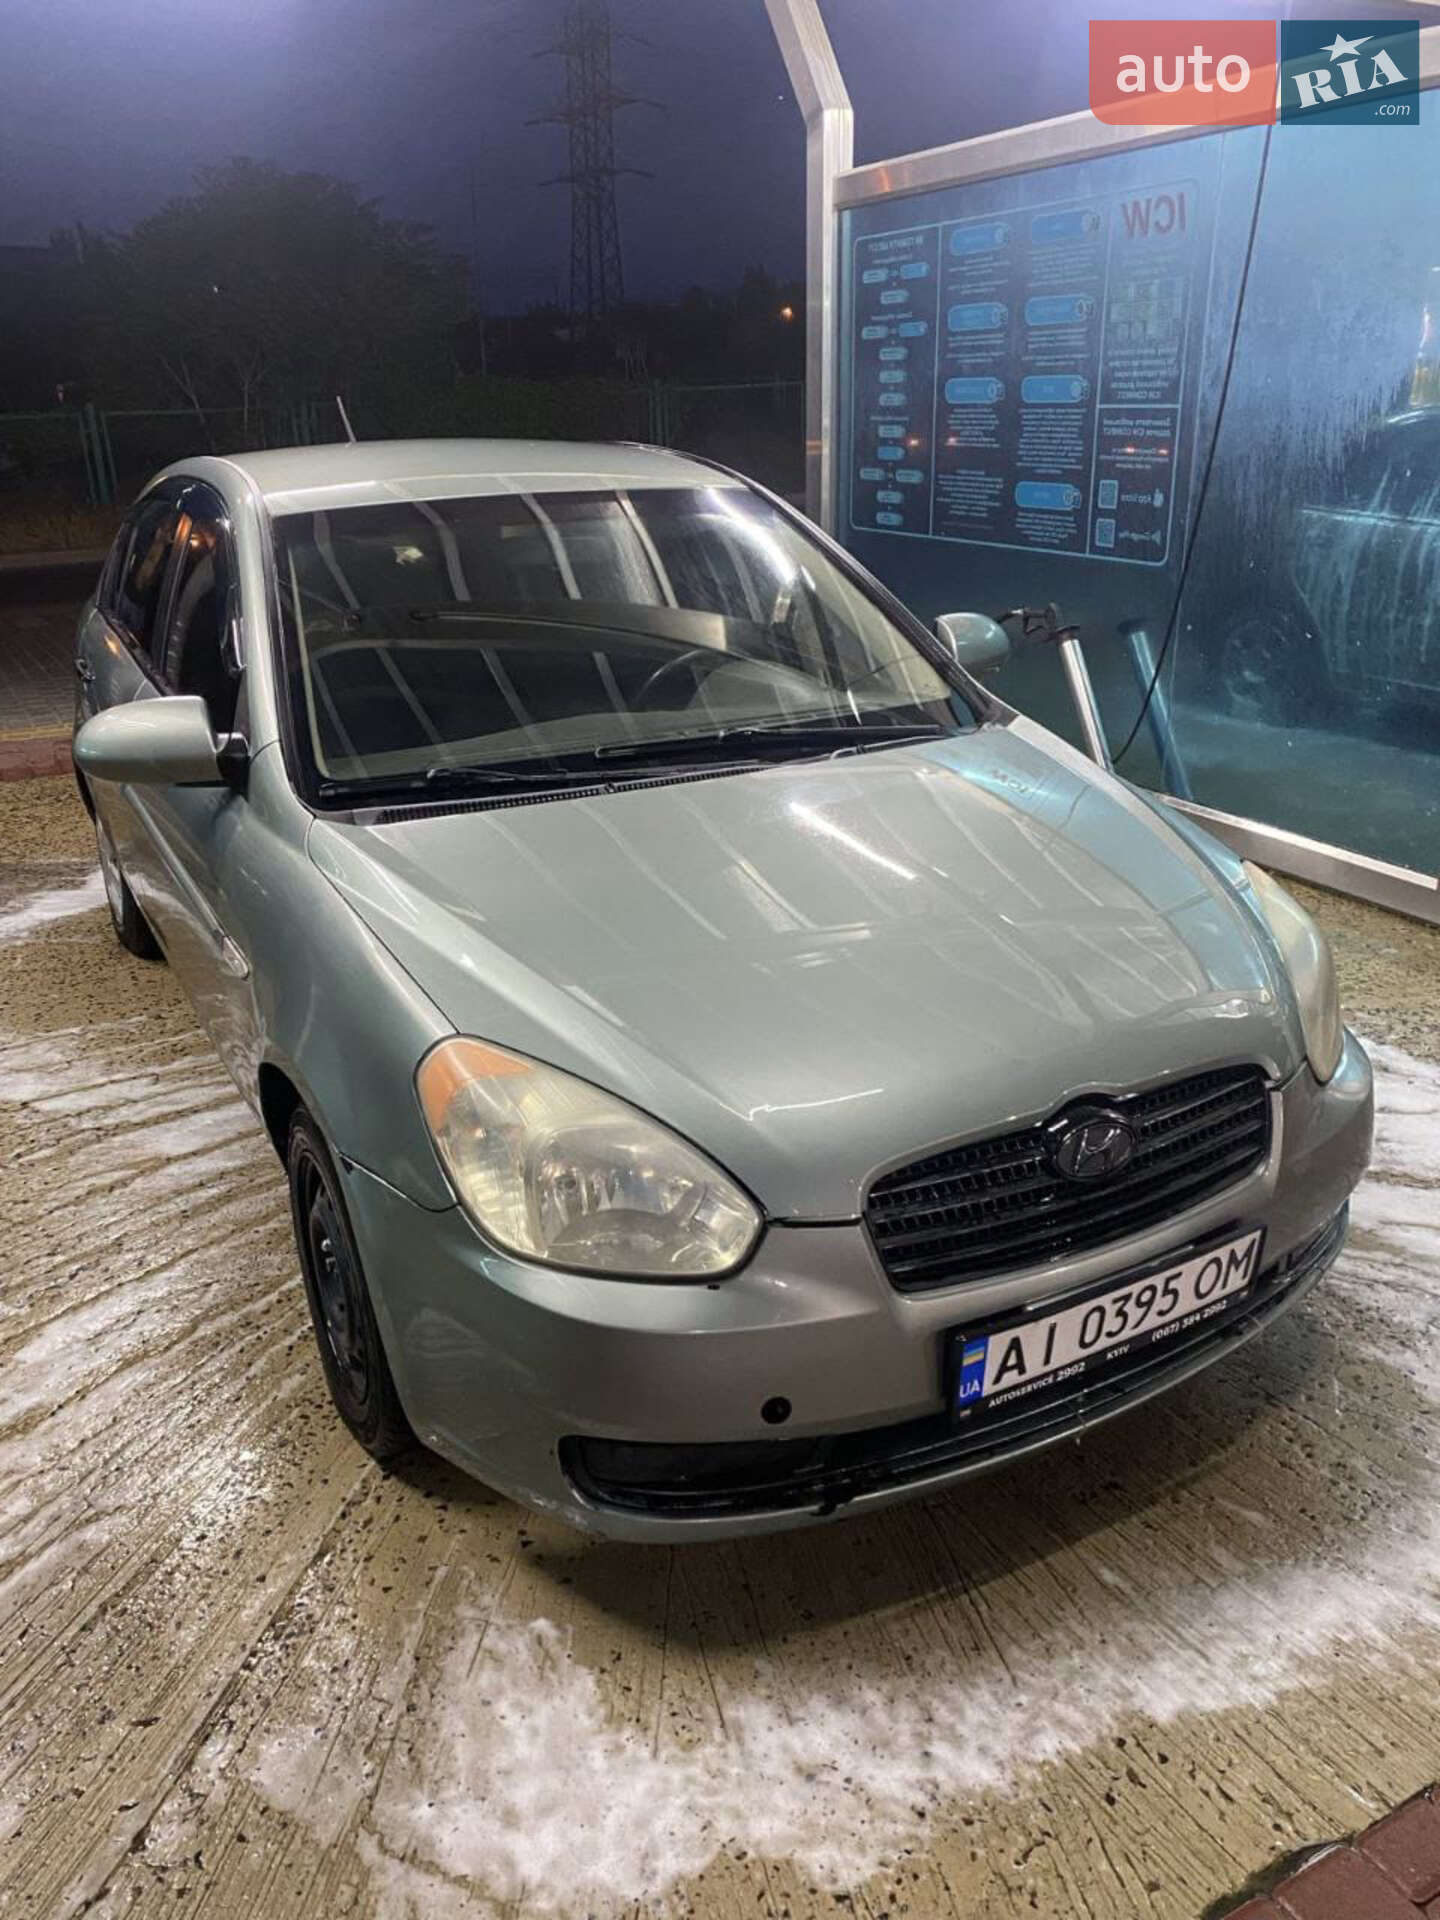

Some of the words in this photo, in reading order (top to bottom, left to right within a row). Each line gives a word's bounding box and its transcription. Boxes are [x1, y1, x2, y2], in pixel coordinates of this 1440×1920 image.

[992, 1323, 1056, 1386] AI
[1078, 1272, 1183, 1350] 0395
[1194, 1238, 1257, 1299] OM
[960, 1379, 980, 1398] UA
